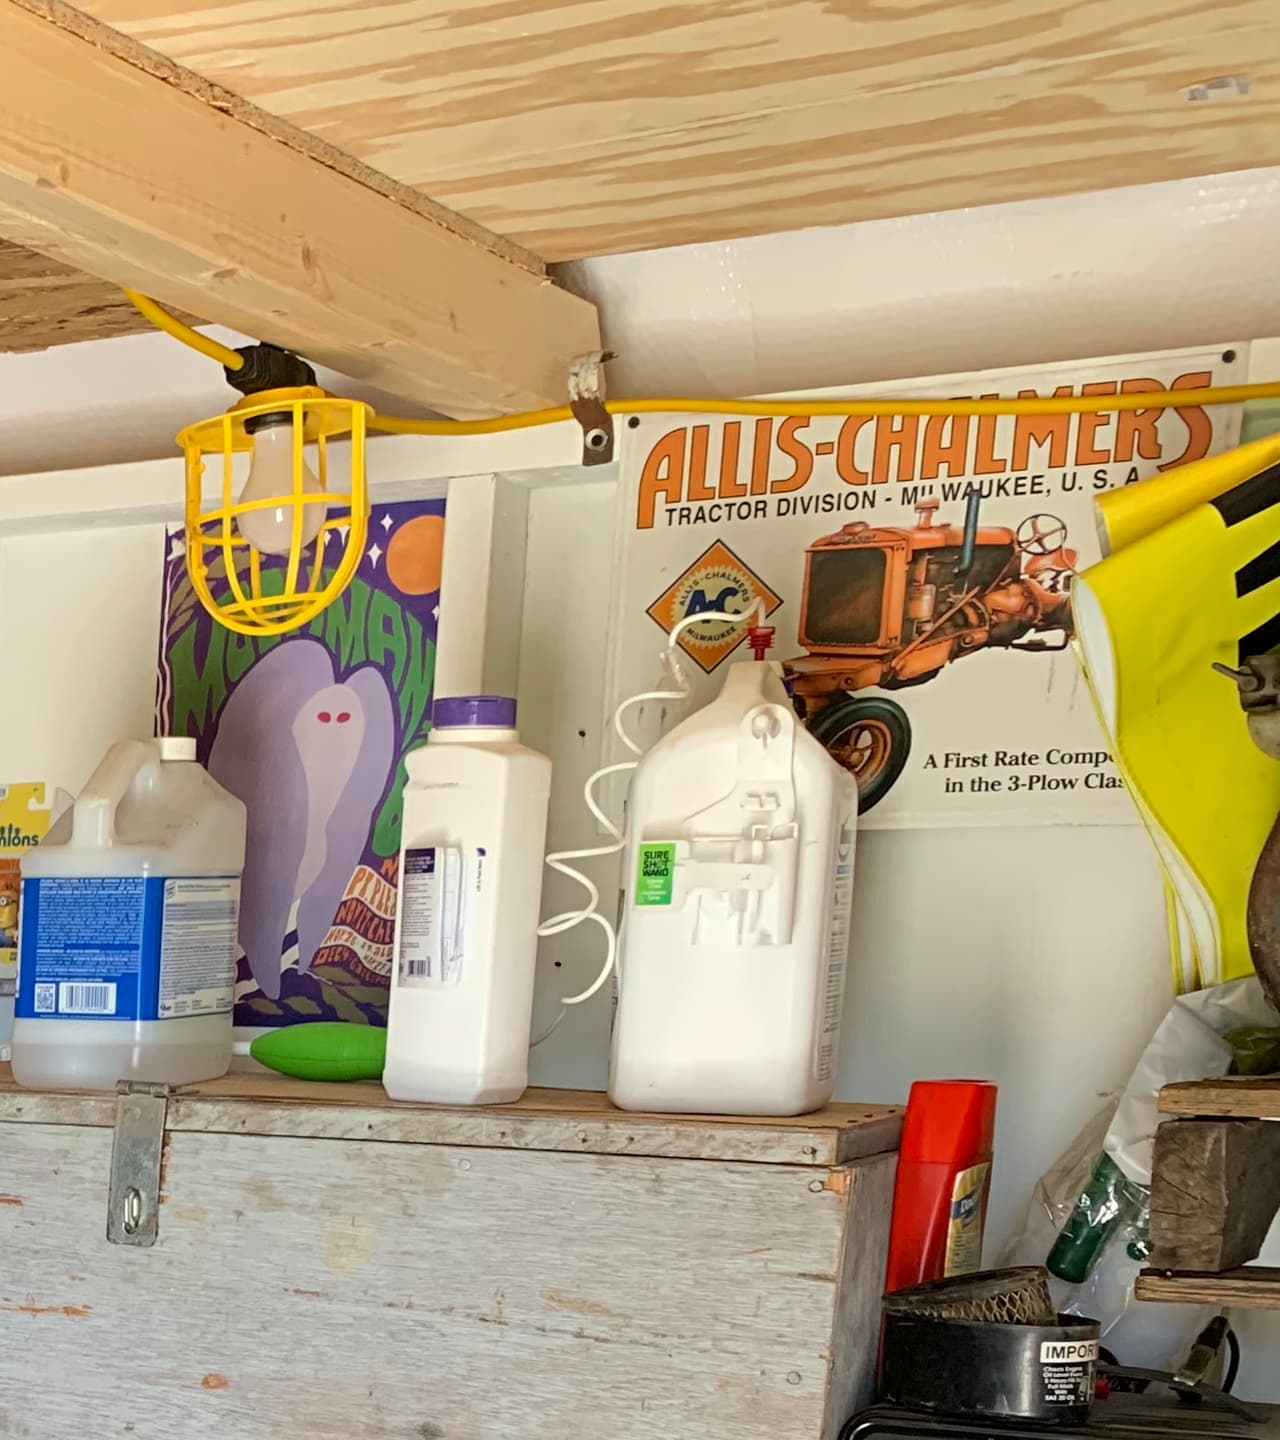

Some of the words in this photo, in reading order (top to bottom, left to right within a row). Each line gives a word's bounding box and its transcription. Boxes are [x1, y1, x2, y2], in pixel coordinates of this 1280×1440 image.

[636, 371, 1212, 529] ALLIS-CHALMERS
[665, 500, 767, 527] TRACTOR
[777, 490, 877, 517] DIVISION
[1061, 472, 1083, 492] U.
[1092, 469, 1114, 489] S.
[679, 572, 750, 607] ALLIS-CHALMERS
[687, 626, 736, 641] MILWAUKEE
[923, 754, 938, 769] A
[943, 752, 988, 768] First
[994, 750, 1040, 767] Rate
[944, 777, 964, 793] in
[970, 776, 1002, 793] the
[1007, 775, 1080, 791] 3-Plow
[643, 859, 670, 869] SHOT
[644, 851, 670, 860] SURE
[642, 868, 669, 877] WAND
